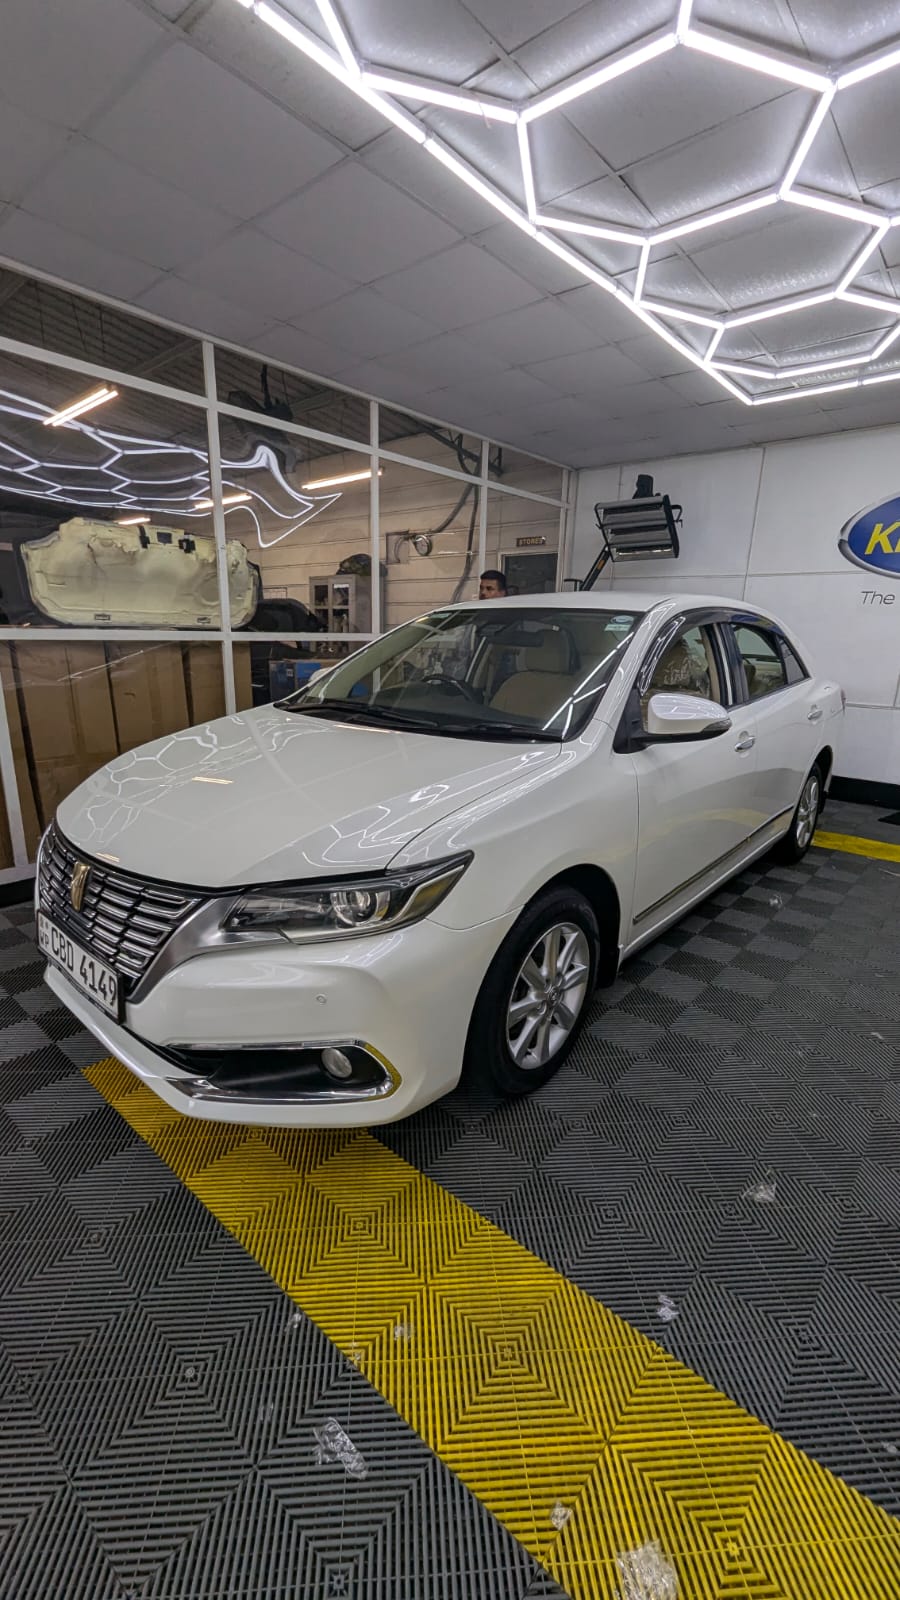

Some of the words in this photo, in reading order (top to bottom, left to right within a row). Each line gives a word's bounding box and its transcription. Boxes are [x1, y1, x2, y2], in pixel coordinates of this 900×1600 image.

[861, 591, 896, 605] The
[51, 926, 74, 972] CBD
[80, 954, 117, 1007] 4149
